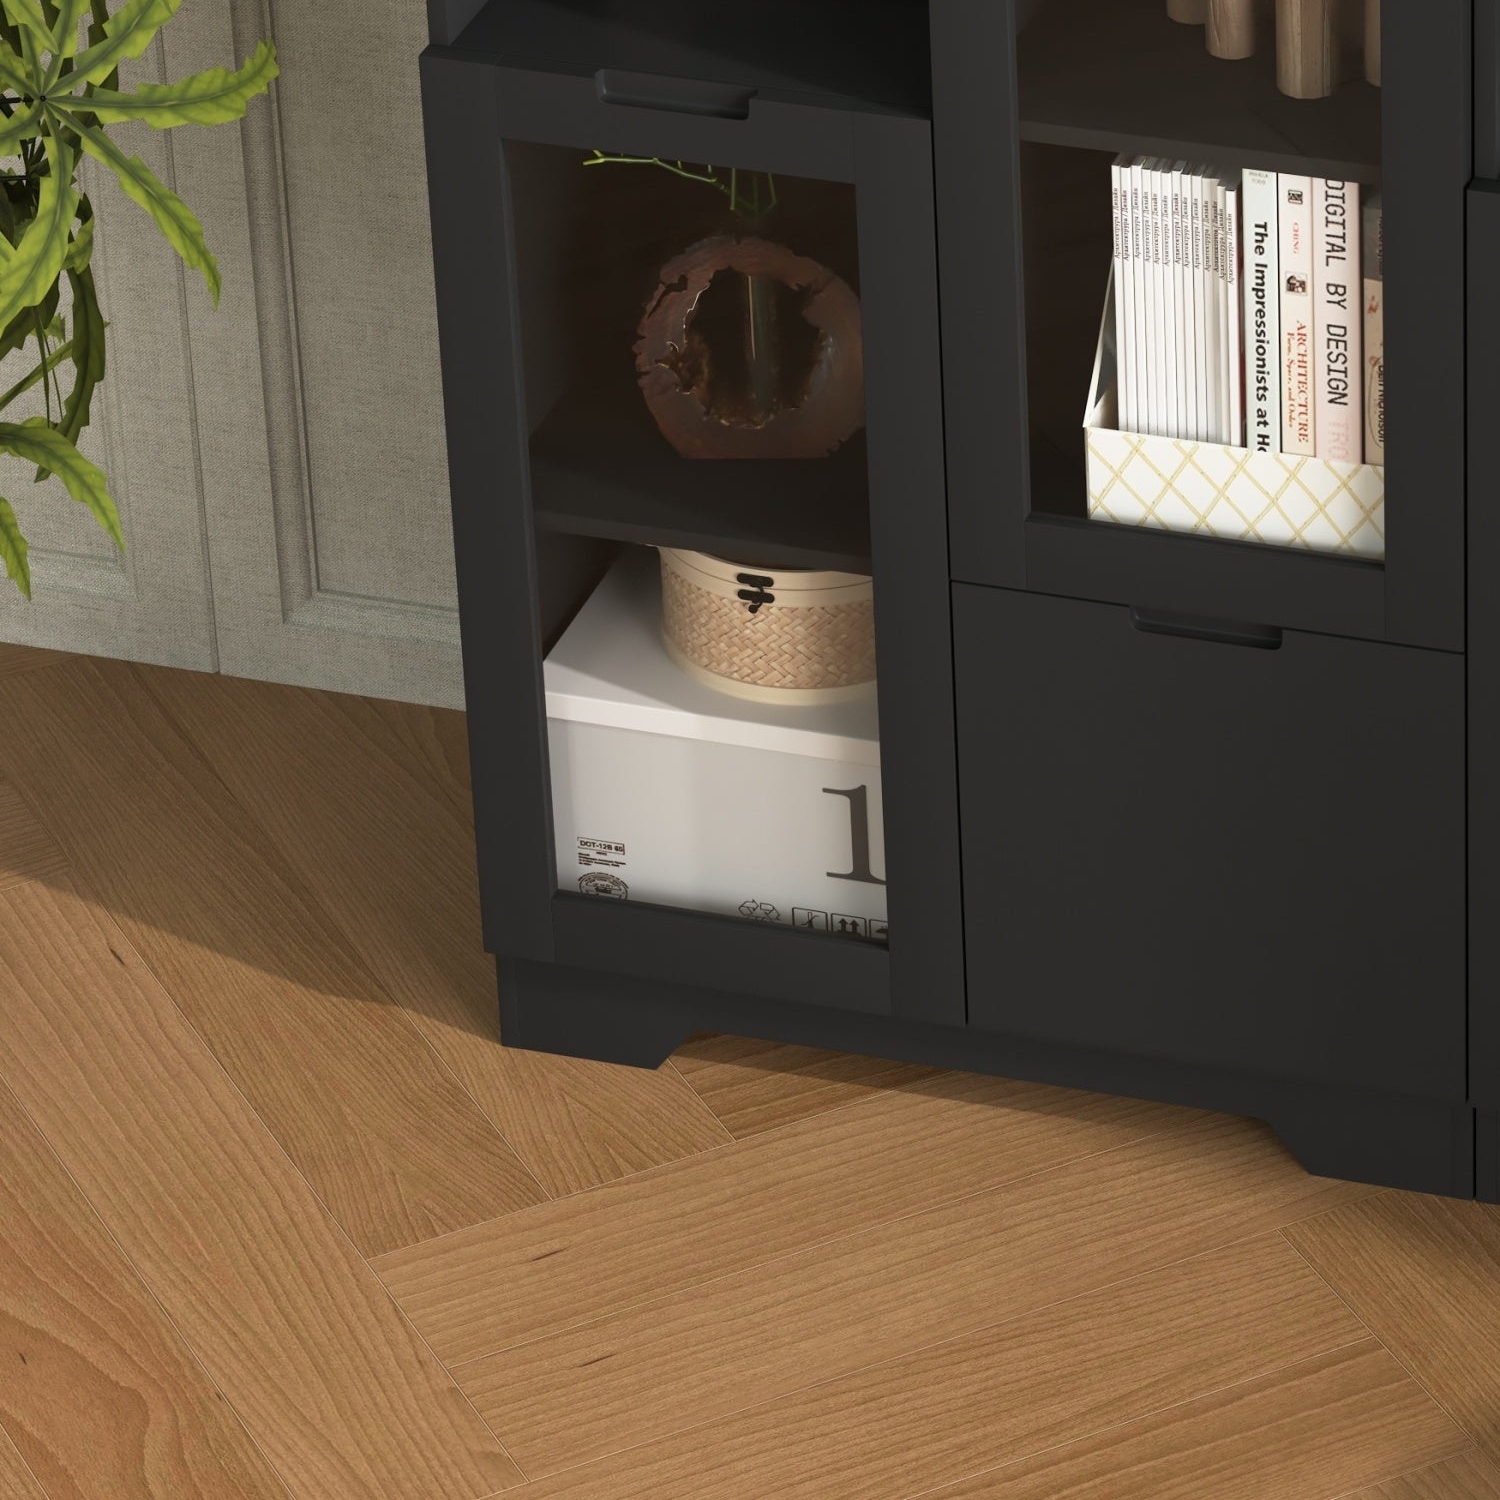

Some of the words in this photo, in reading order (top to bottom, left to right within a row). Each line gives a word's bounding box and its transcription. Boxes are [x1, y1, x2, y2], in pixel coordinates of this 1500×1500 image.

[1253, 221, 1269, 256] The
[1324, 178, 1347, 268] DIGITAL
[1251, 262, 1270, 402] Impressionists
[1325, 282, 1348, 310] BY
[1296, 319, 1309, 443] ARCHITECTURE
[1326, 323, 1349, 406] DESIGN
[1256, 407, 1270, 428] at
